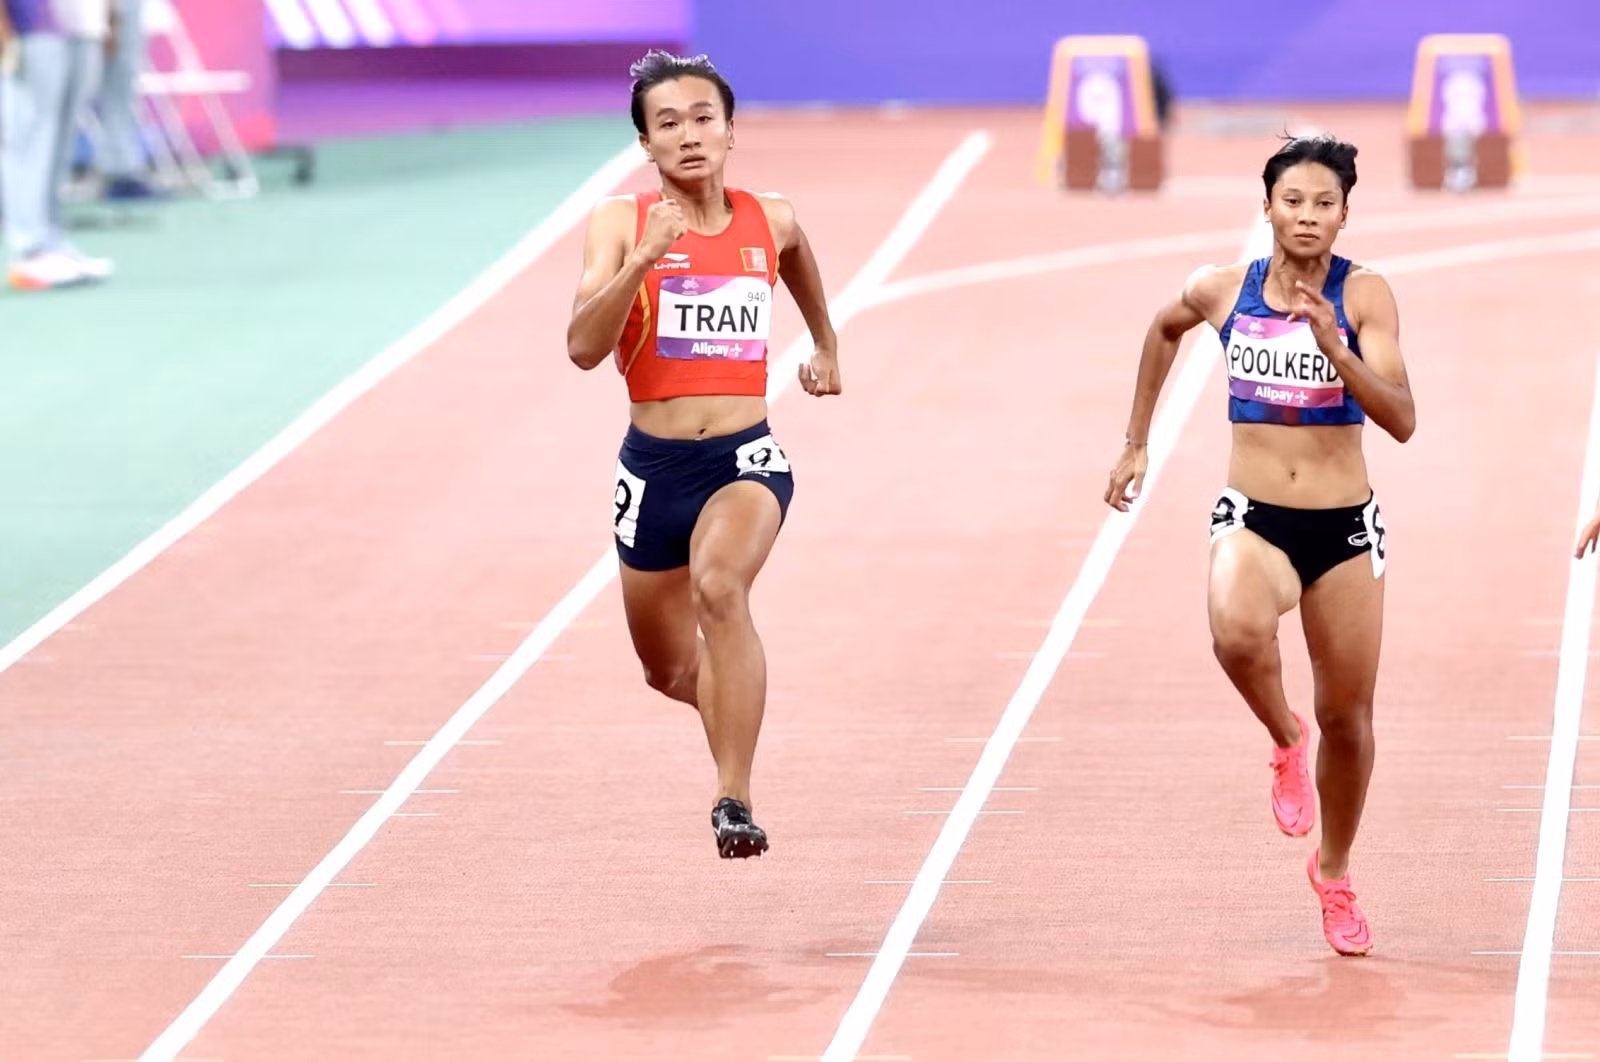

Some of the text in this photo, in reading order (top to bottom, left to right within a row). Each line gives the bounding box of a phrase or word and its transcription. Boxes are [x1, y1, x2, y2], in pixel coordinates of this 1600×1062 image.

[747, 291, 767, 303] 940
[674, 303, 759, 333] TRAN
[1230, 344, 1340, 383] POOLKERD
[747, 447, 772, 468] 9
